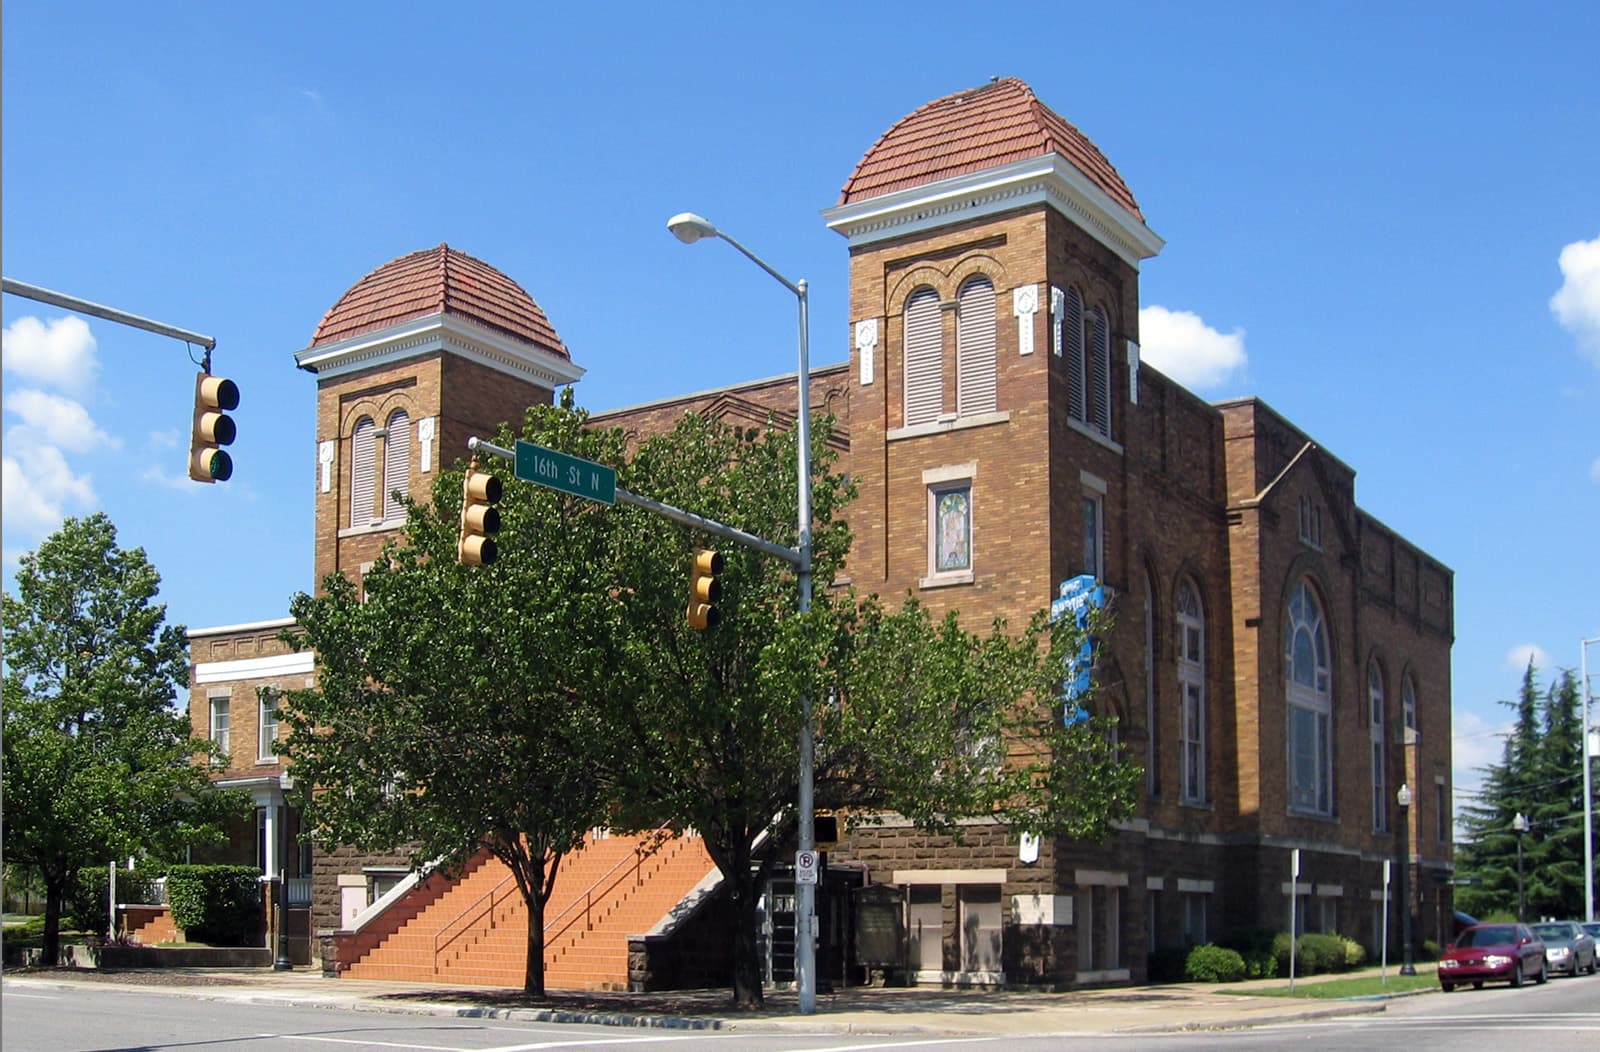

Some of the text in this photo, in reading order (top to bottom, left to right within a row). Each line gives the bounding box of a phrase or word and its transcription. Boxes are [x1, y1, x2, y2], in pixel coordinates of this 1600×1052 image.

[533, 455, 600, 491] 16th St N
